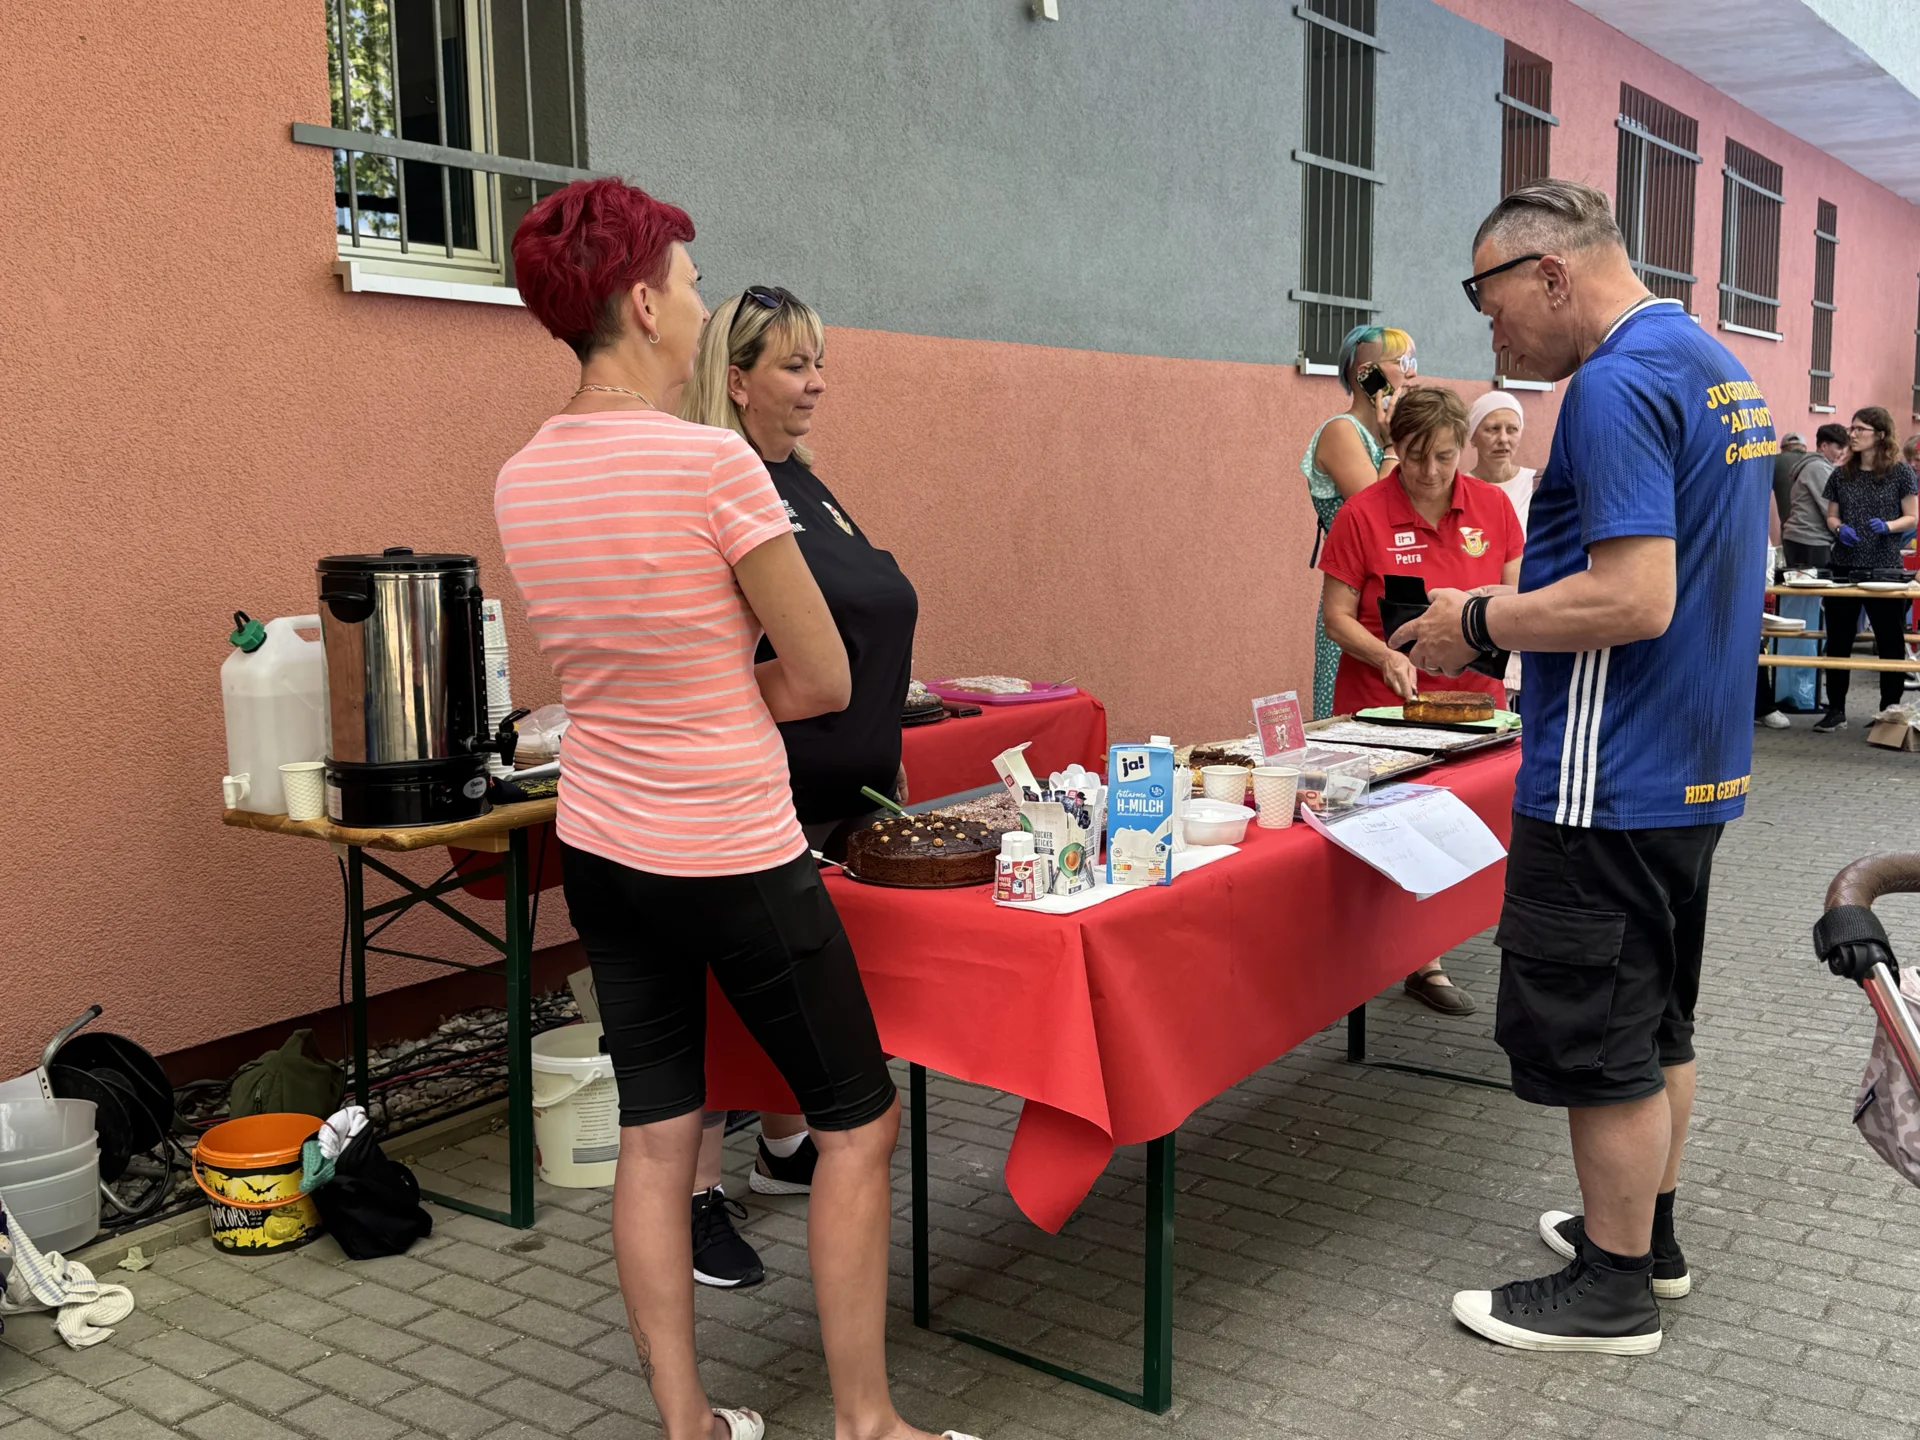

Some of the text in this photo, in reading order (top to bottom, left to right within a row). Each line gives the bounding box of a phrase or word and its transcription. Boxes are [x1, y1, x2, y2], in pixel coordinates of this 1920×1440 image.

[1395, 553, 1422, 565] Petra
[1122, 755, 1145, 778] ja!
[1684, 784, 1715, 804] HIER
[1716, 779, 1740, 800] GEHT
[1116, 798, 1164, 814] H-MILCH
[1001, 862, 1011, 873] ja!
[209, 1204, 249, 1229] POPCORN
